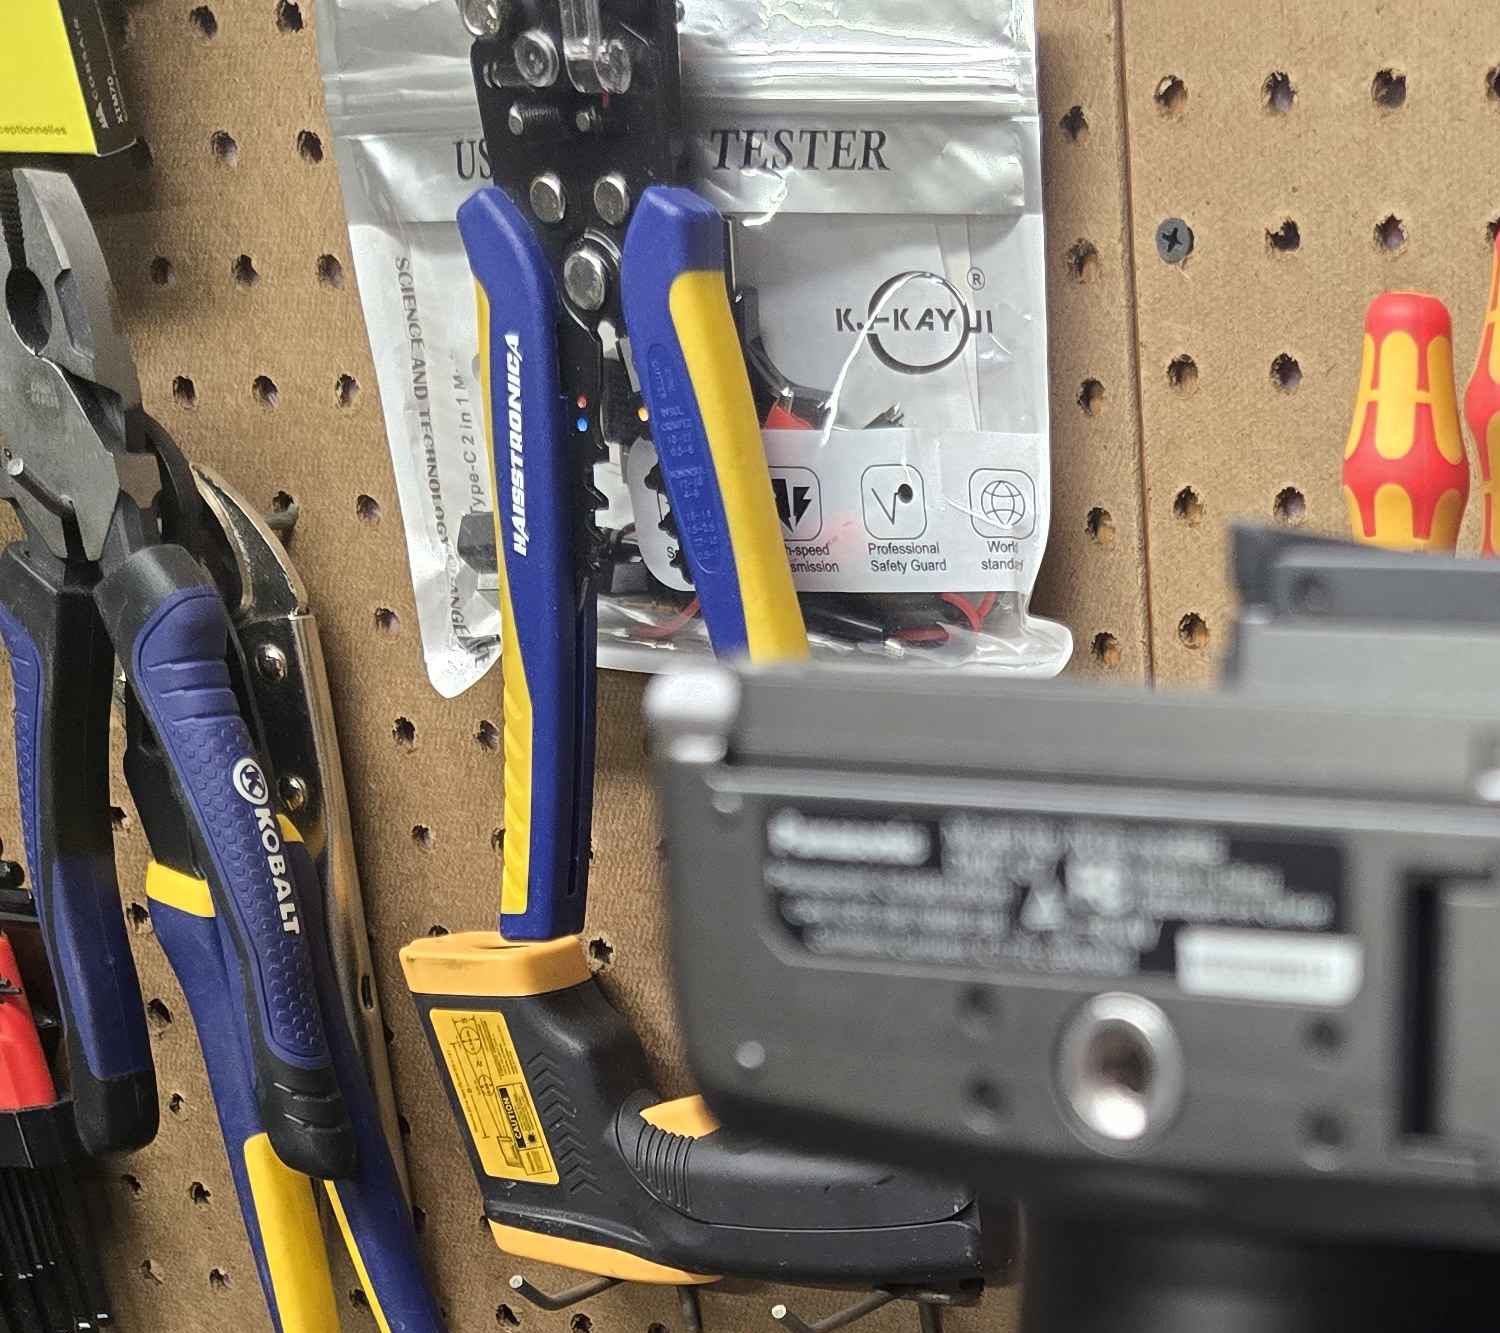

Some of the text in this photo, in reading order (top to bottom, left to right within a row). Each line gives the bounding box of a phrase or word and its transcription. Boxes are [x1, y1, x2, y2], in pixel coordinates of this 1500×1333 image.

[711, 129, 891, 171] TESTER
[395, 257, 425, 350] SCIENCE
[412, 357, 429, 400] AND
[504, 333, 529, 557] HAISSTRONICA
[791, 560, 840, 573] smission
[868, 542, 940, 556] Professional
[871, 560, 947, 574] Safety Guard
[254, 807, 300, 935] KOBALT
[502, 1096, 523, 1140] CAUTION
